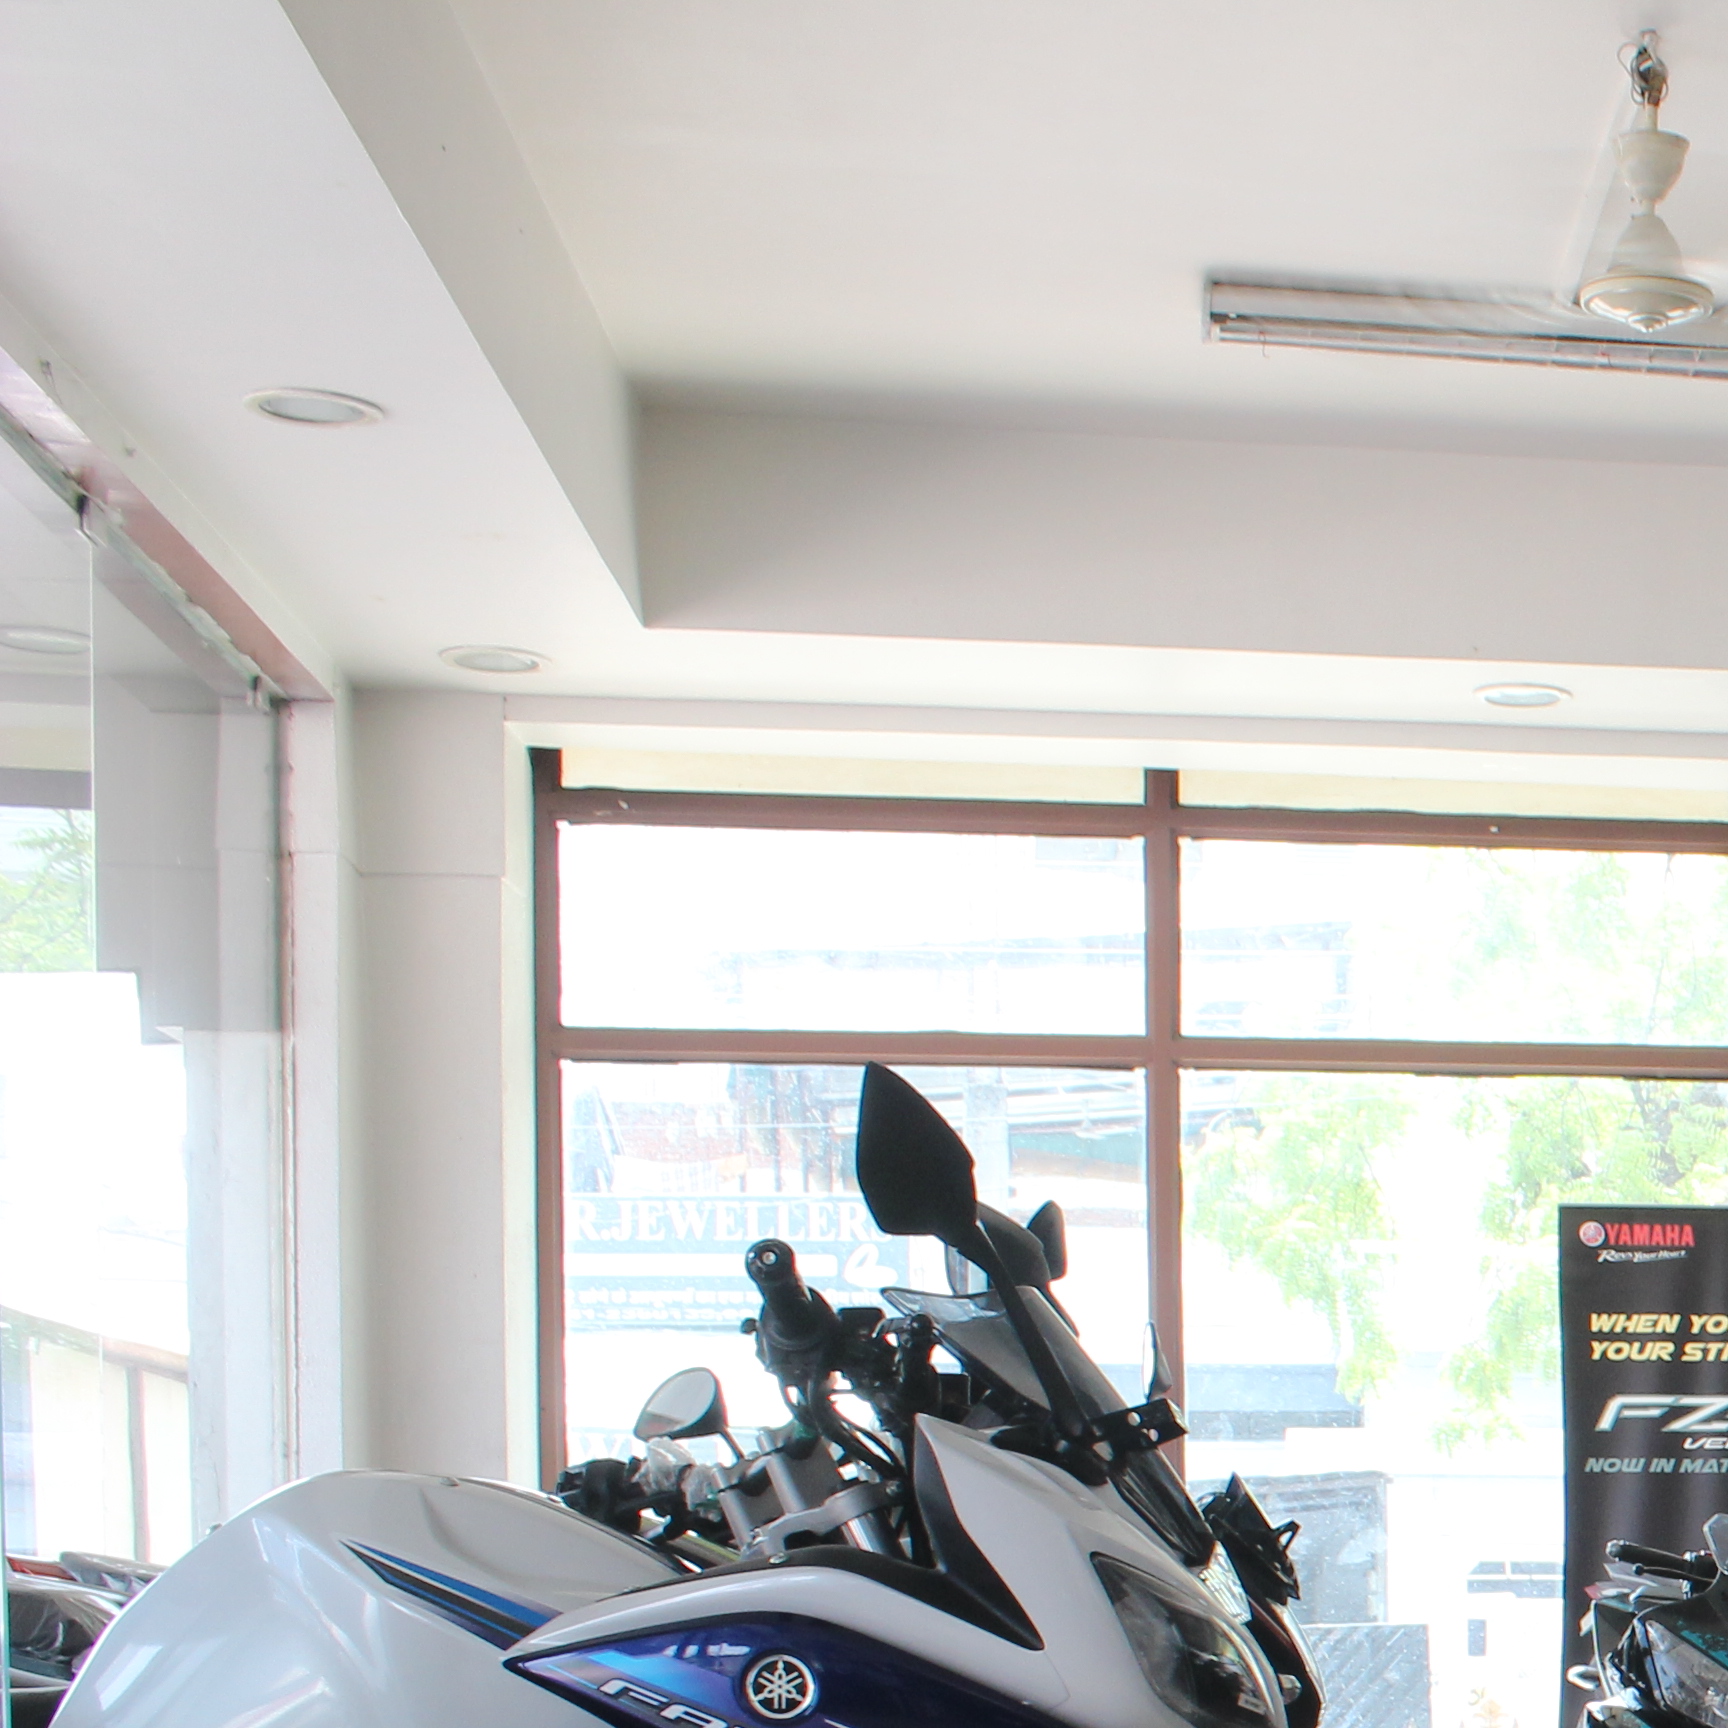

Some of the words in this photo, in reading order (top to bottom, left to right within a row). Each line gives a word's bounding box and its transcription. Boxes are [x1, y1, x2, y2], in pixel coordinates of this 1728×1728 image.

[1604, 1223, 1695, 1247] YAMAHA
[1589, 1313, 1681, 1334] WHEN
[1590, 1341, 1675, 1362] YOUR
[1585, 1458, 1645, 1474] NOW
[1649, 1459, 1674, 1474] IN
